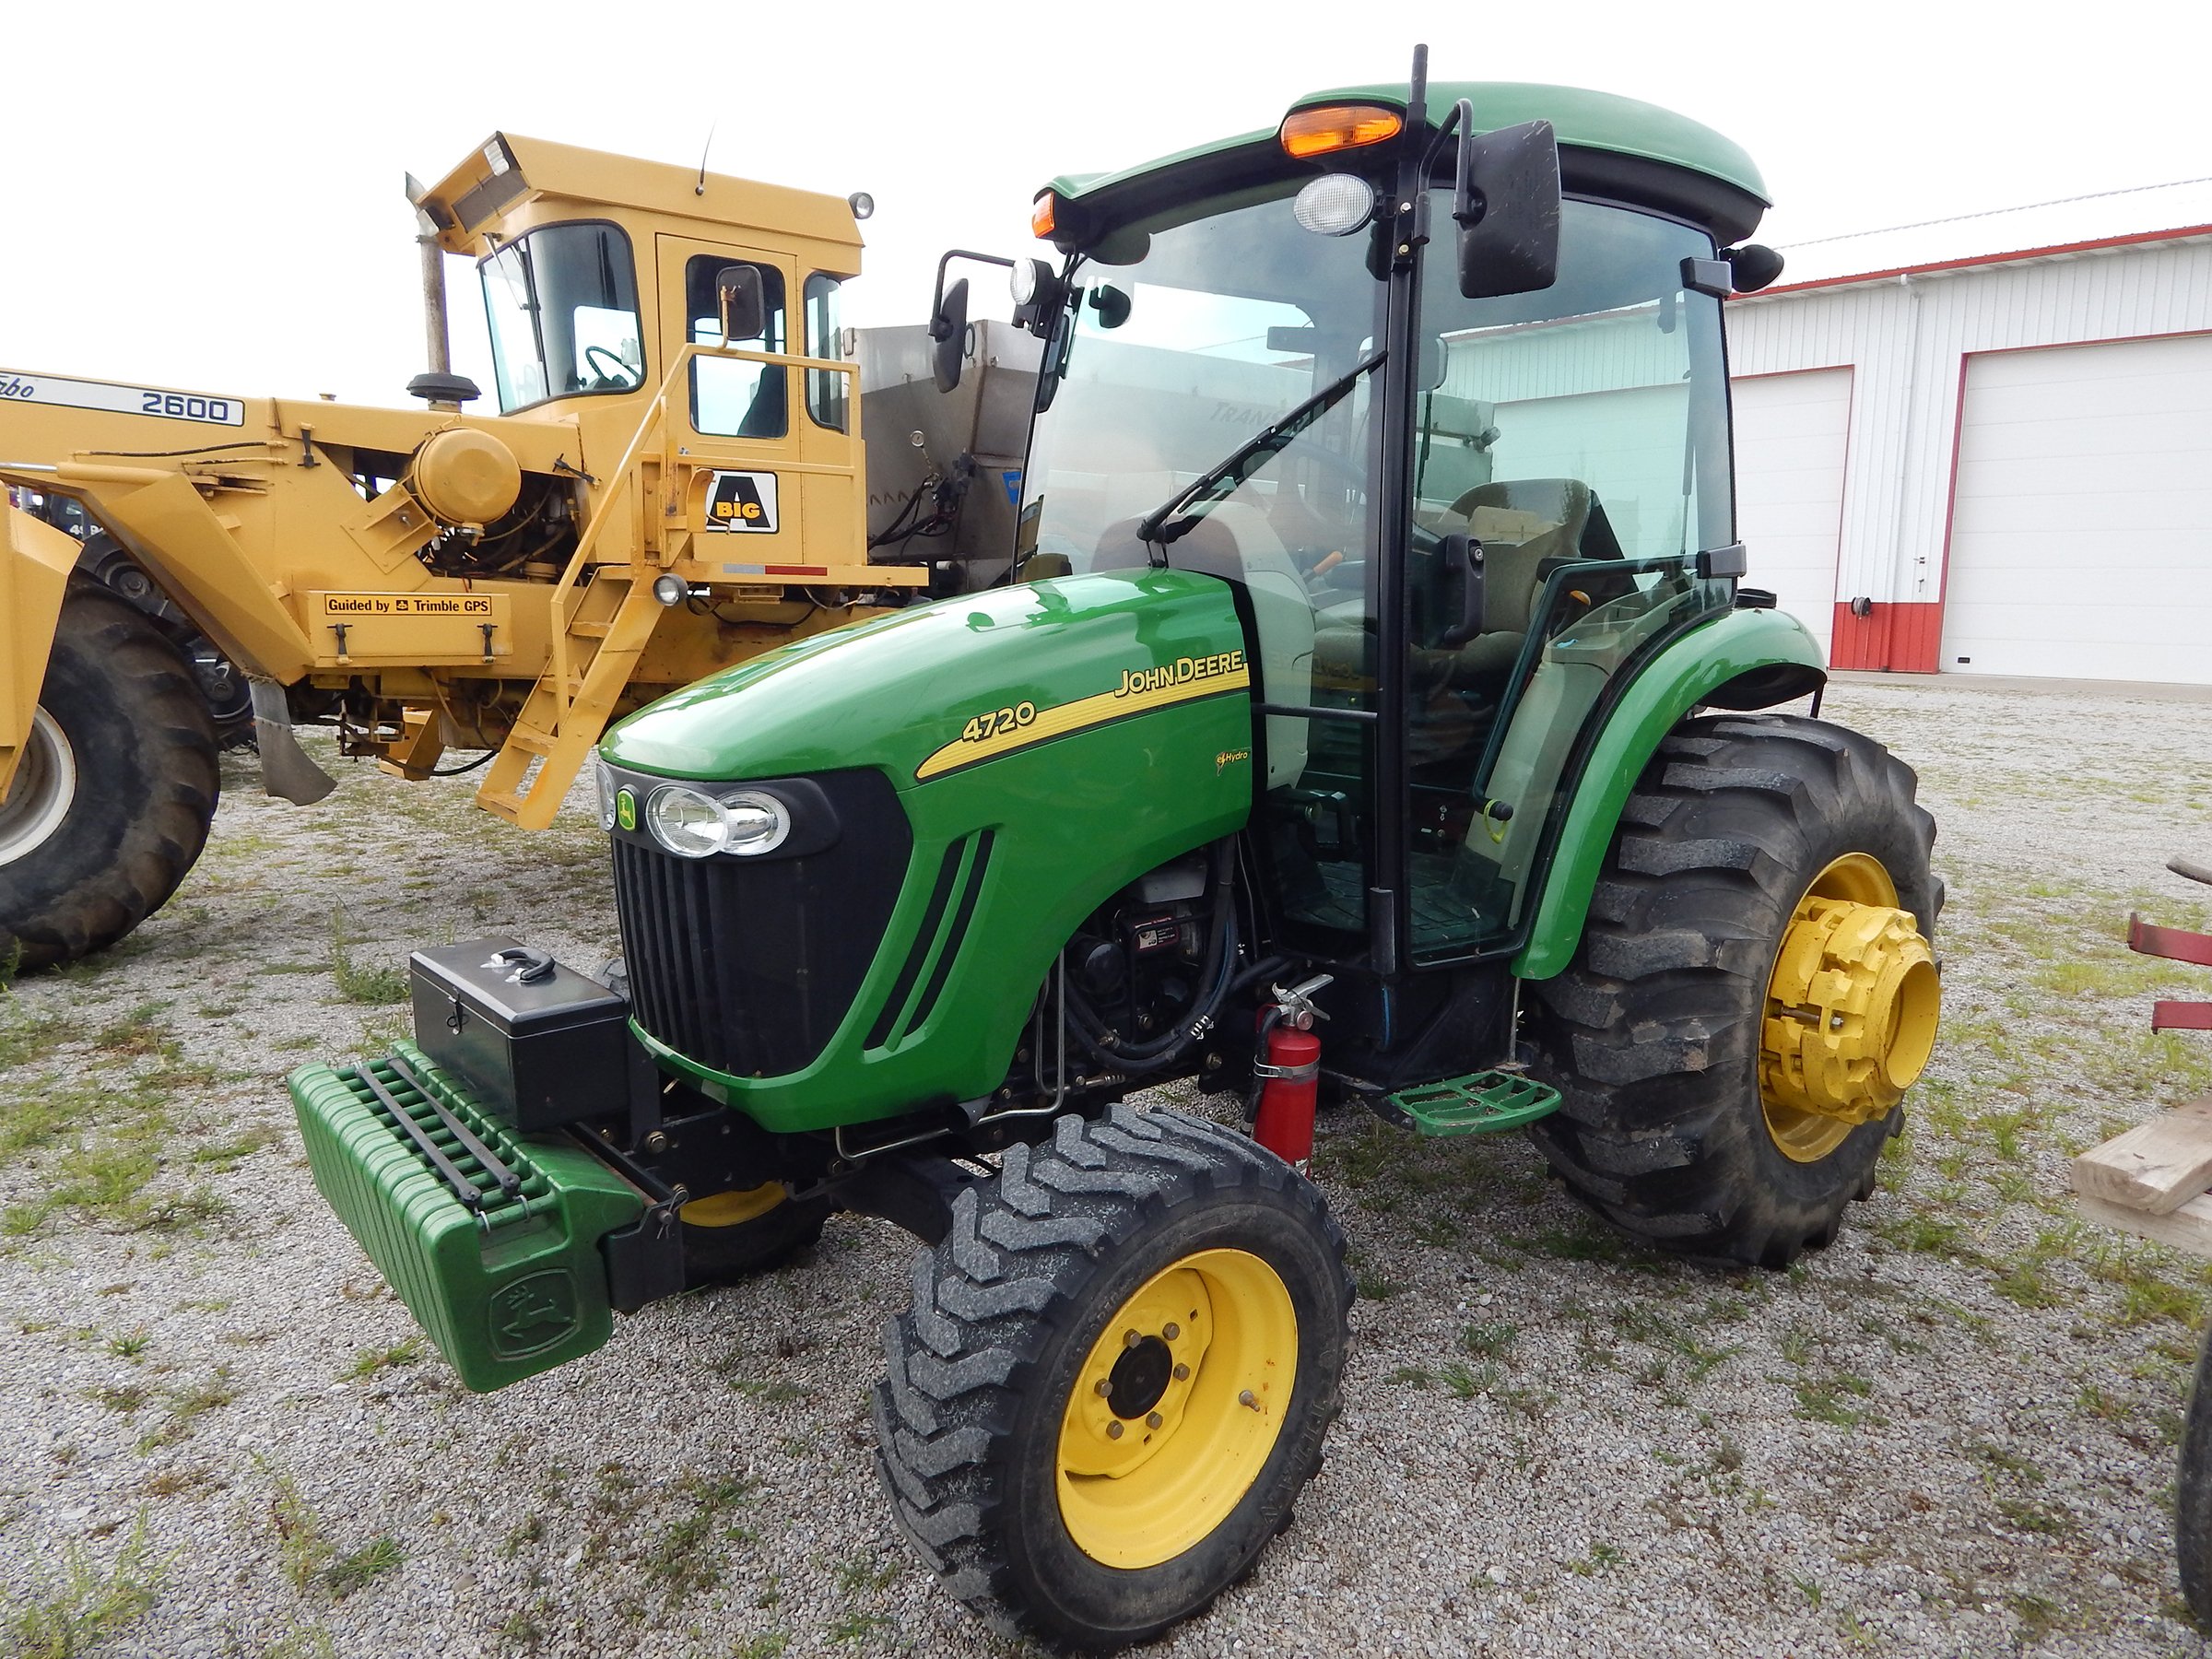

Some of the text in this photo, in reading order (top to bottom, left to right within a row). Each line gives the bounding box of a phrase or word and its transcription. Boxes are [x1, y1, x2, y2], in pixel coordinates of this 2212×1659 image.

[143, 393, 228, 421] 2600
[716, 501, 760, 519] BIG
[328, 599, 488, 612] Guided by Trimble GPS
[1114, 665, 1176, 698] JOHN
[1176, 650, 1243, 685] DEERE
[962, 700, 1037, 742] 4720
